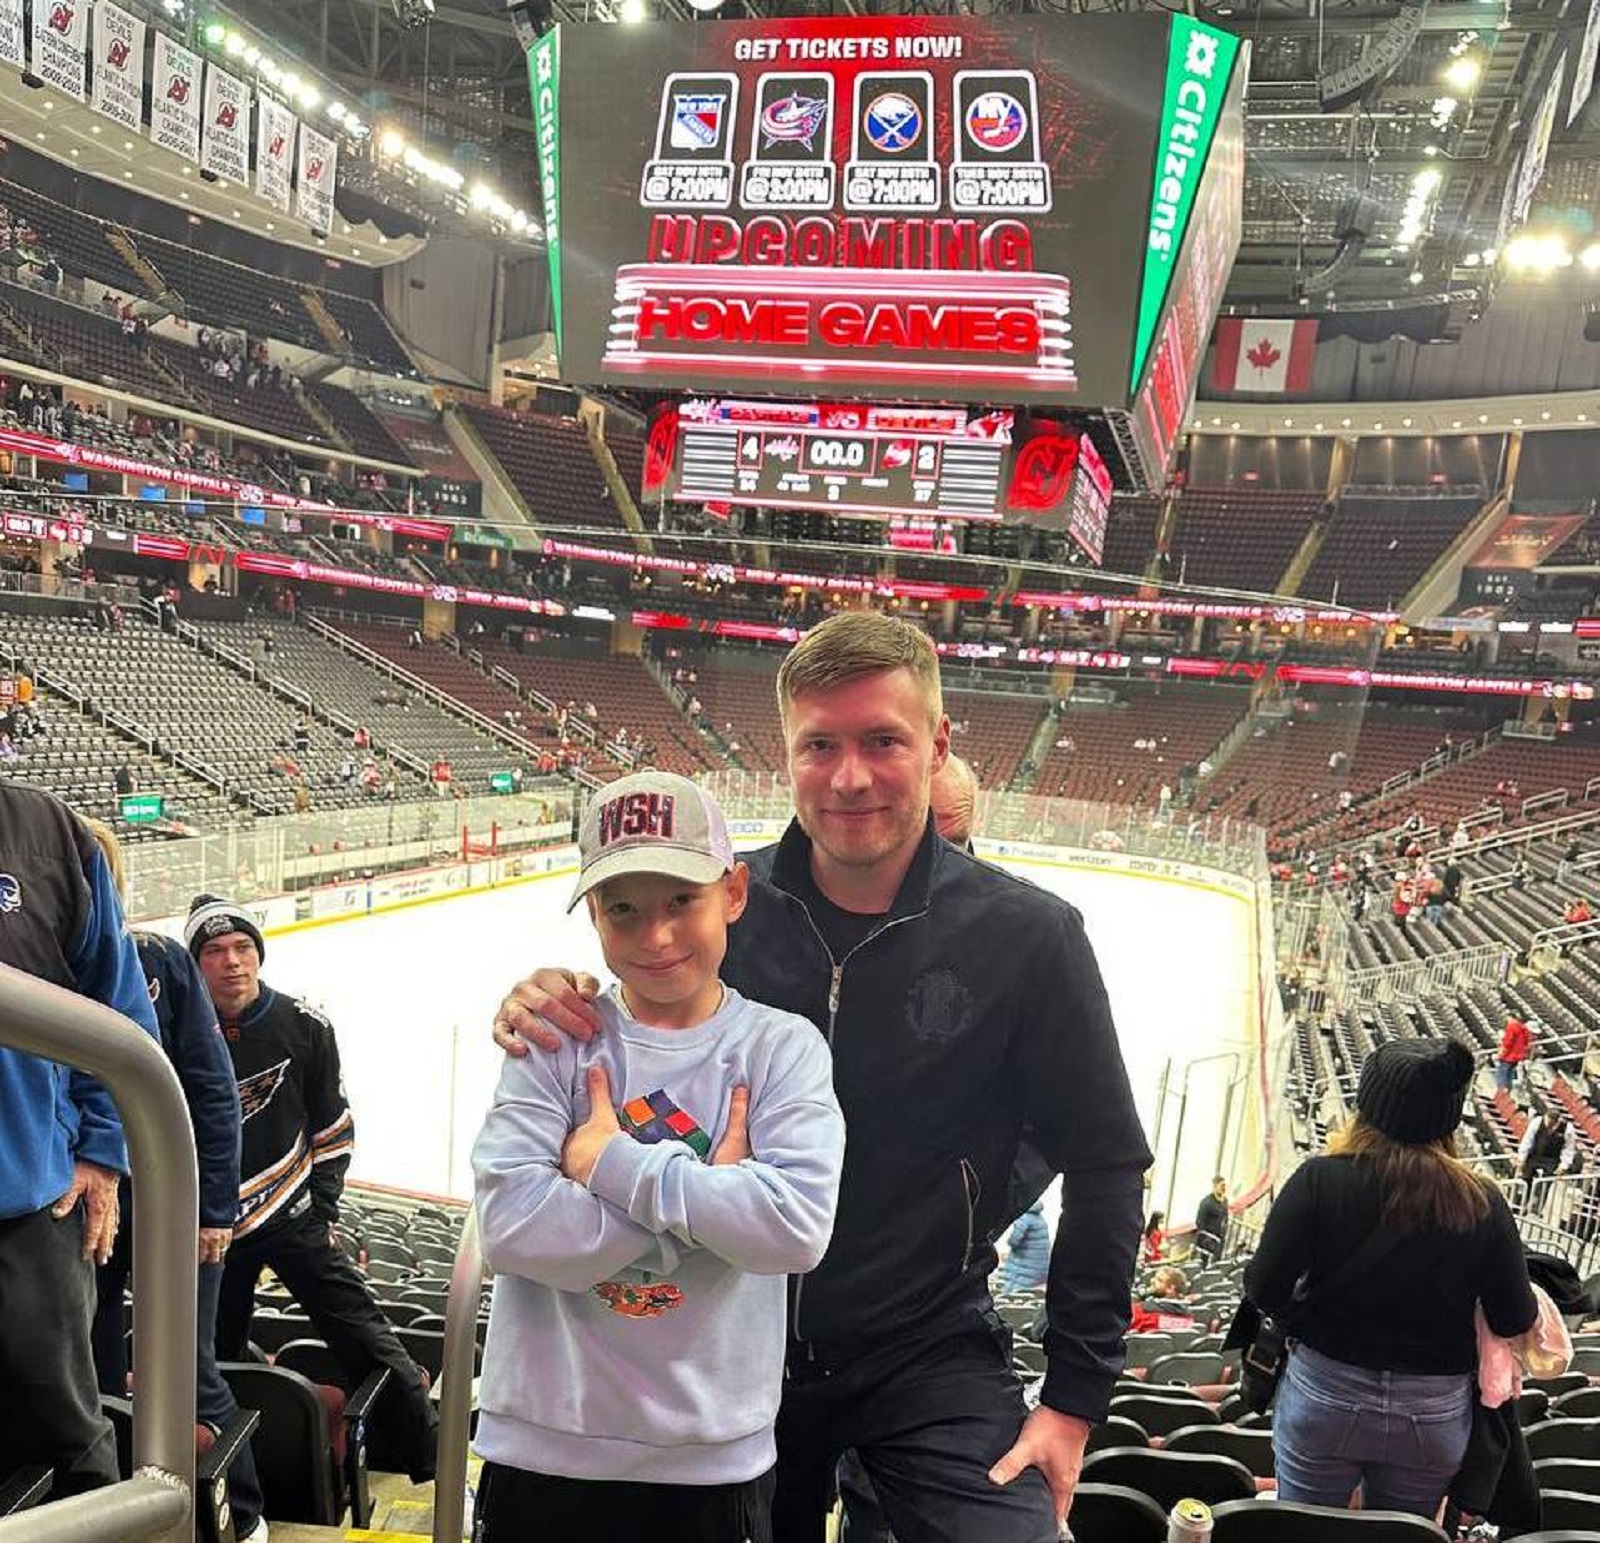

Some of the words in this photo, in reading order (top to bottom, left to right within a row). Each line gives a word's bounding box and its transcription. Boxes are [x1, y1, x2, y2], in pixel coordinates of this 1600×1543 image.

[735, 38, 782, 60] GET
[785, 37, 889, 59] TICKETS
[895, 36, 963, 58] NOW!
[1149, 79, 1207, 254] Citizens
[646, 176, 729, 201] @7:00PM
[848, 177, 935, 203] @7:00PM
[956, 178, 1045, 205] @7:00PM
[646, 214, 1035, 272] UPCOMING
[639, 296, 810, 346] HOME
[818, 303, 1042, 355] GAMES
[741, 436, 759, 460] 4
[810, 439, 864, 467] 00.0
[917, 445, 935, 470] 2
[81, 449, 172, 481] WASHINGTON
[173, 470, 231, 493] CAPITALS
[598, 791, 677, 847] WSH
